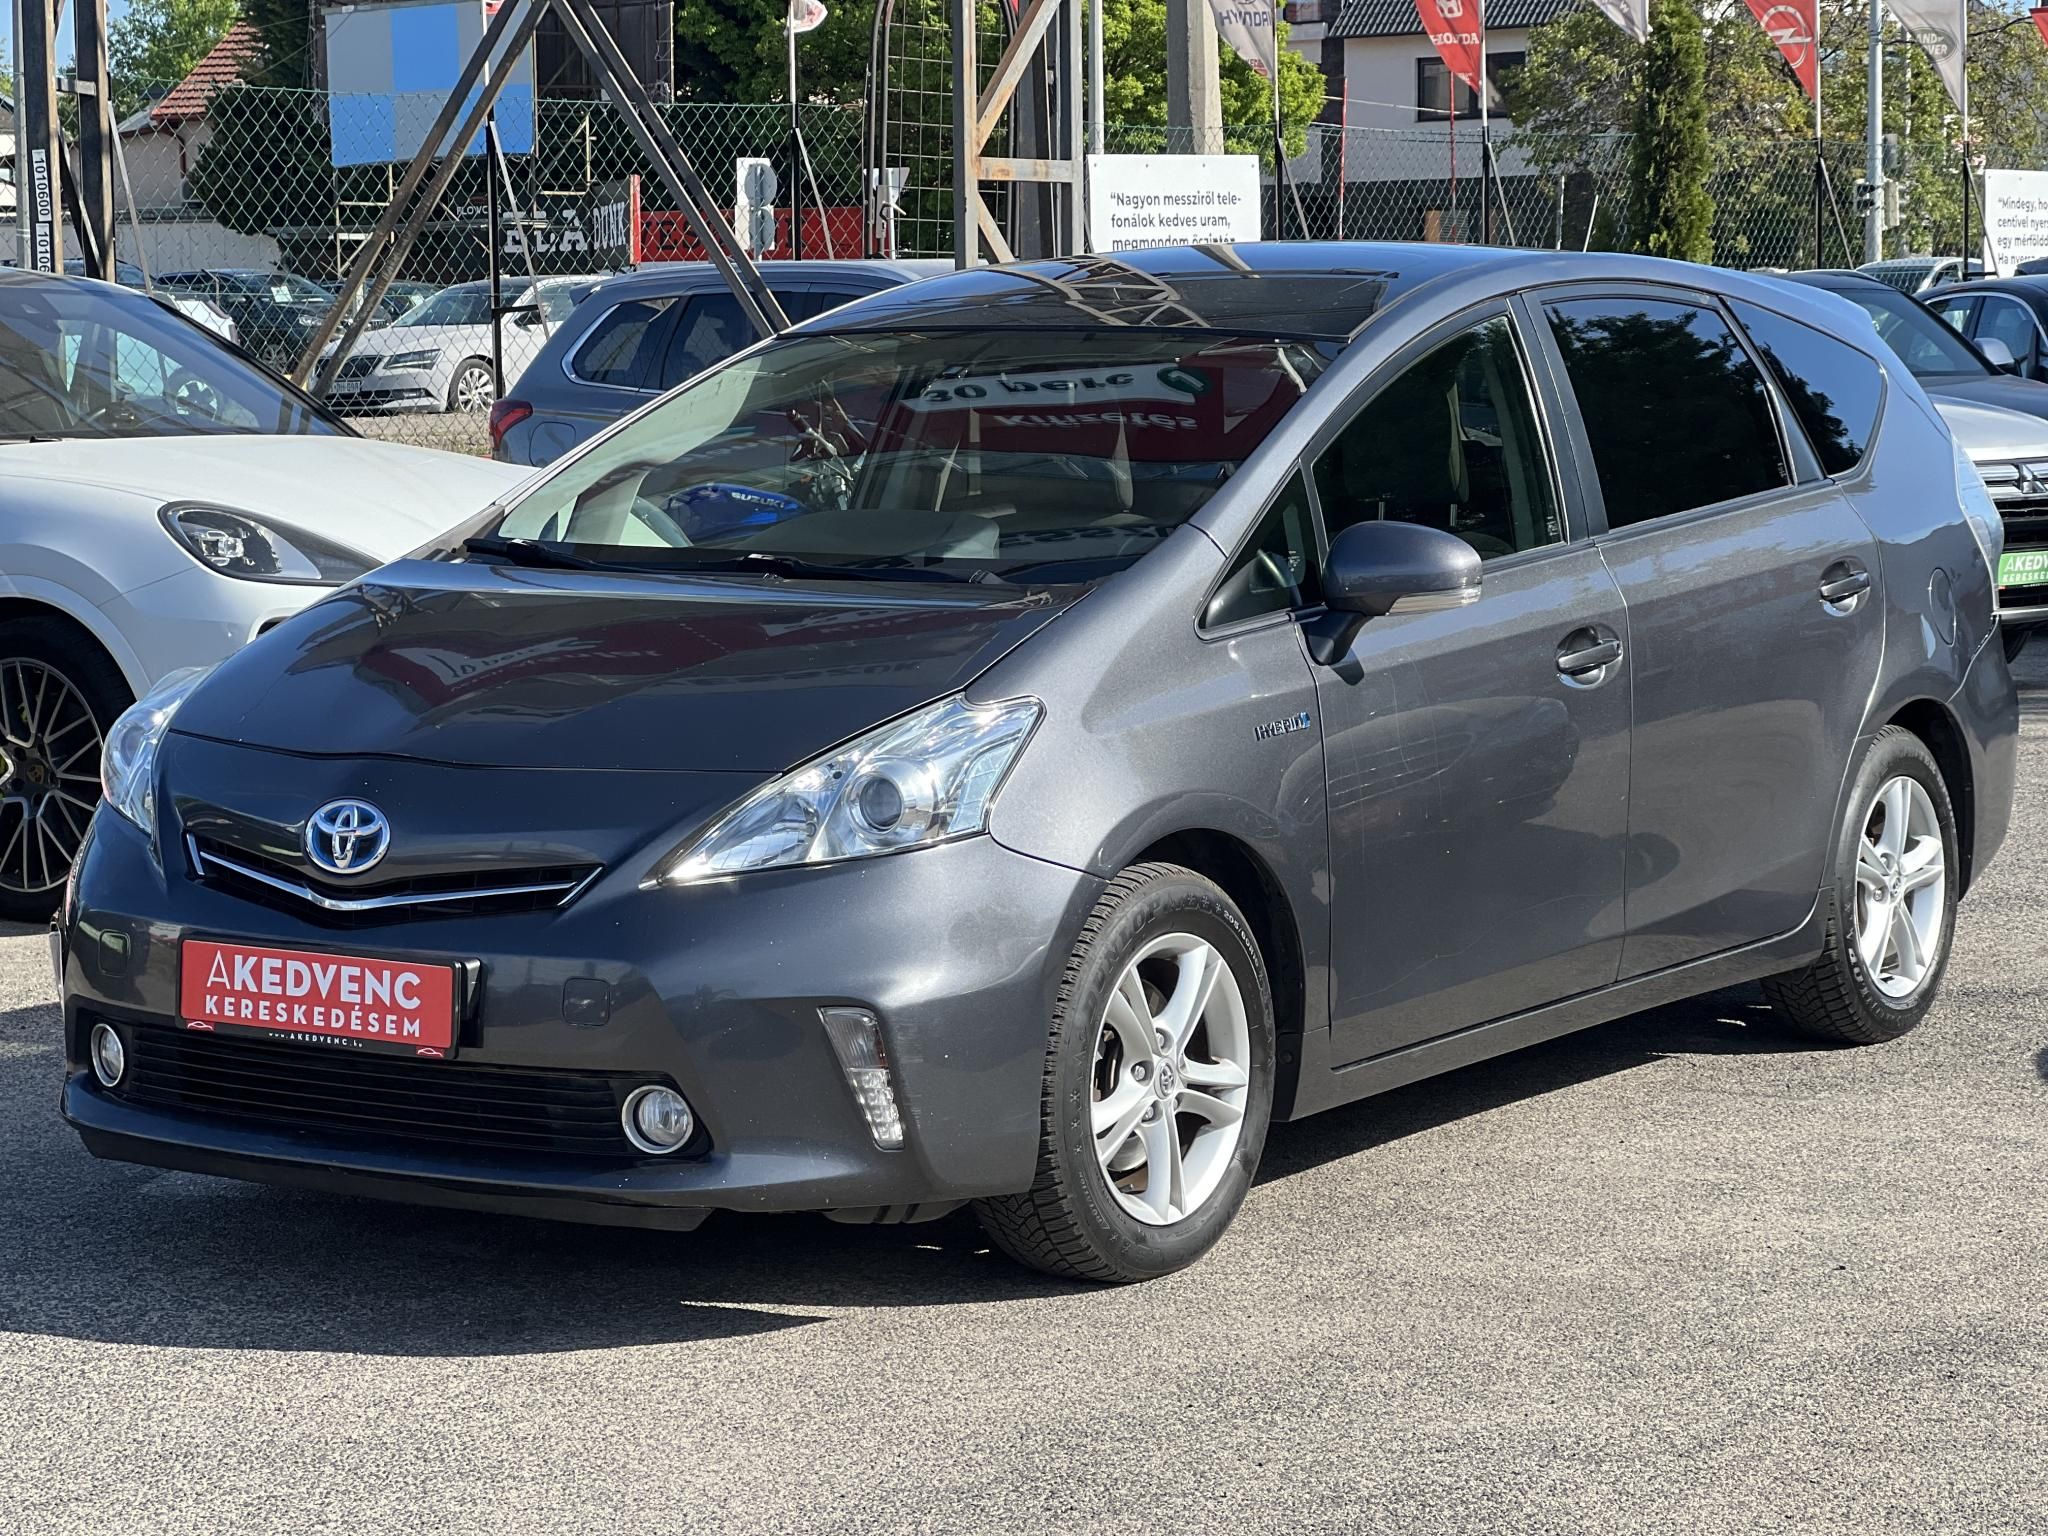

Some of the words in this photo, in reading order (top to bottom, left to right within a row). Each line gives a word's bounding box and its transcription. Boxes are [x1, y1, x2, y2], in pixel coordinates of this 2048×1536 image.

[34, 158, 51, 216] 1010600
[1217, 191, 1242, 206] tele-
[592, 202, 627, 251] DUNK
[1111, 213, 1155, 228] fonálok
[1158, 213, 1197, 227] kedves
[1200, 215, 1231, 229] uram,
[1997, 237, 2012, 249] egy
[1997, 253, 2009, 265] Ha
[206, 949, 422, 1010] AKEDVENC
[204, 994, 421, 1038] KERESKEDÉSEM
